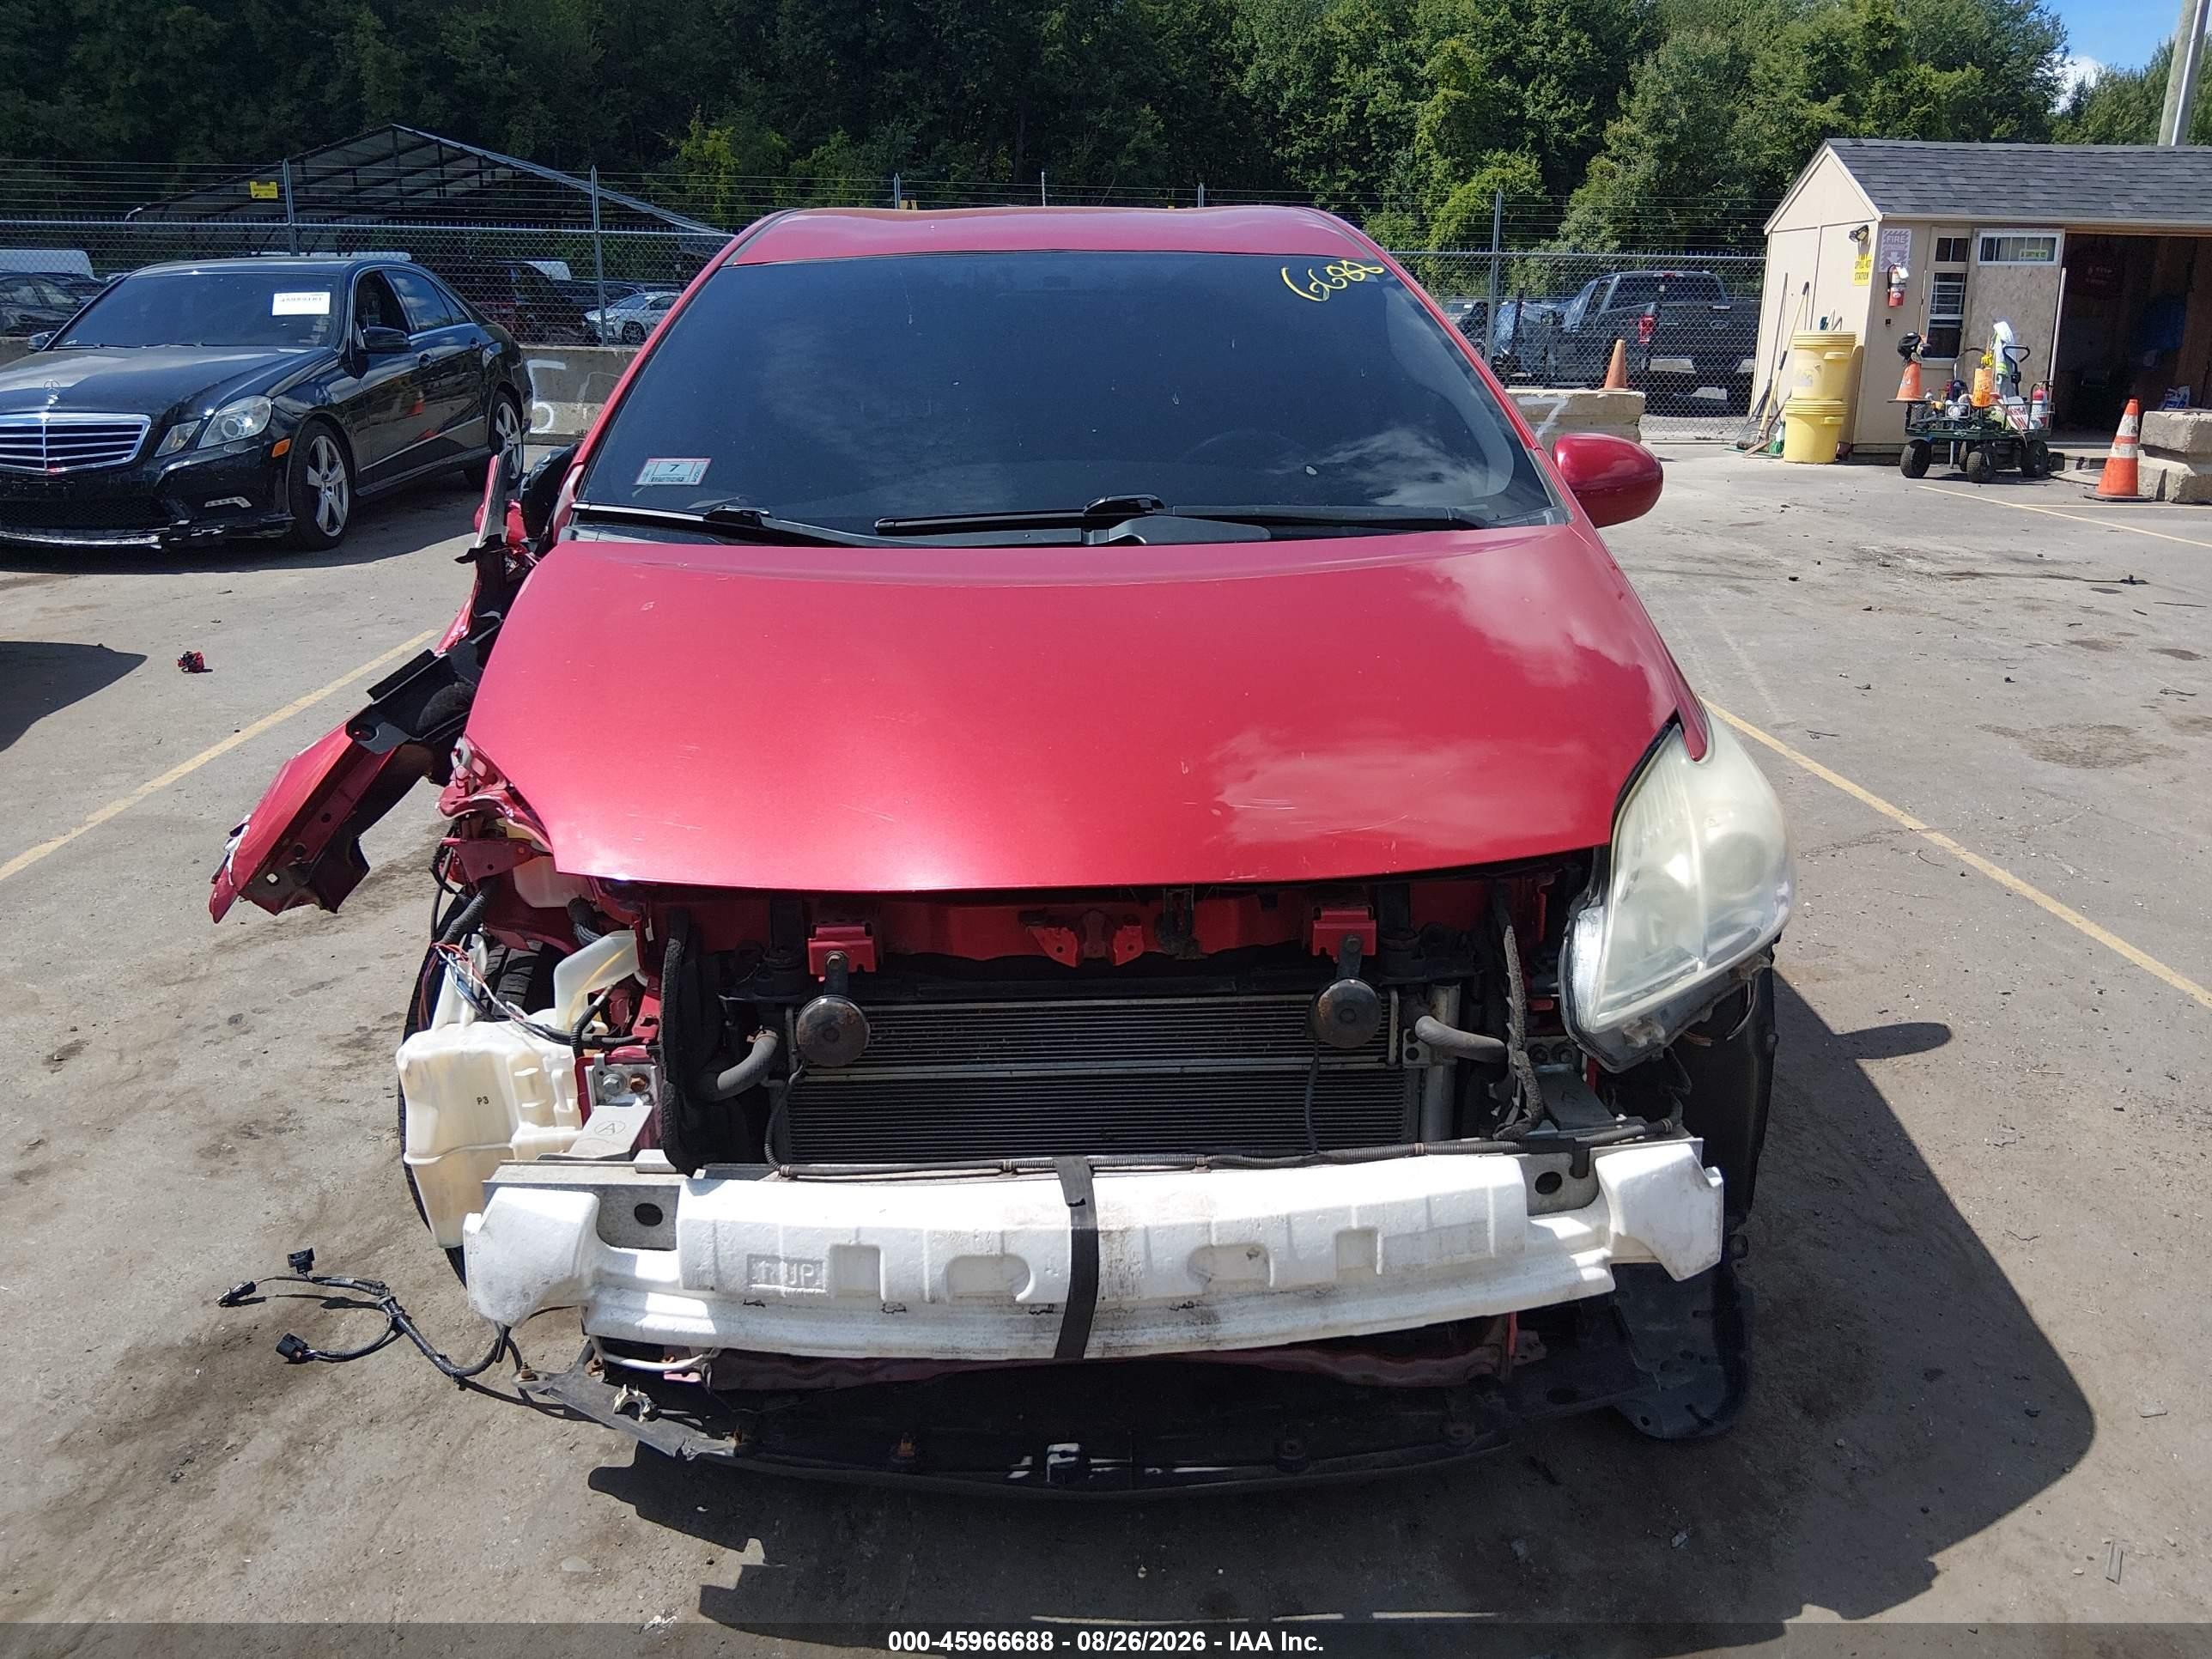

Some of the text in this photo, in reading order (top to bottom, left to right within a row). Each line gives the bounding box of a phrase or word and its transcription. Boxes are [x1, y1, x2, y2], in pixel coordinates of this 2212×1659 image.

[1887, 235, 1906, 244] FIRE
[1854, 271, 1869, 281] STATION
[669, 464, 681, 473] 7
[477, 1096, 489, 1105] P3
[780, 1261, 815, 1286] UP
